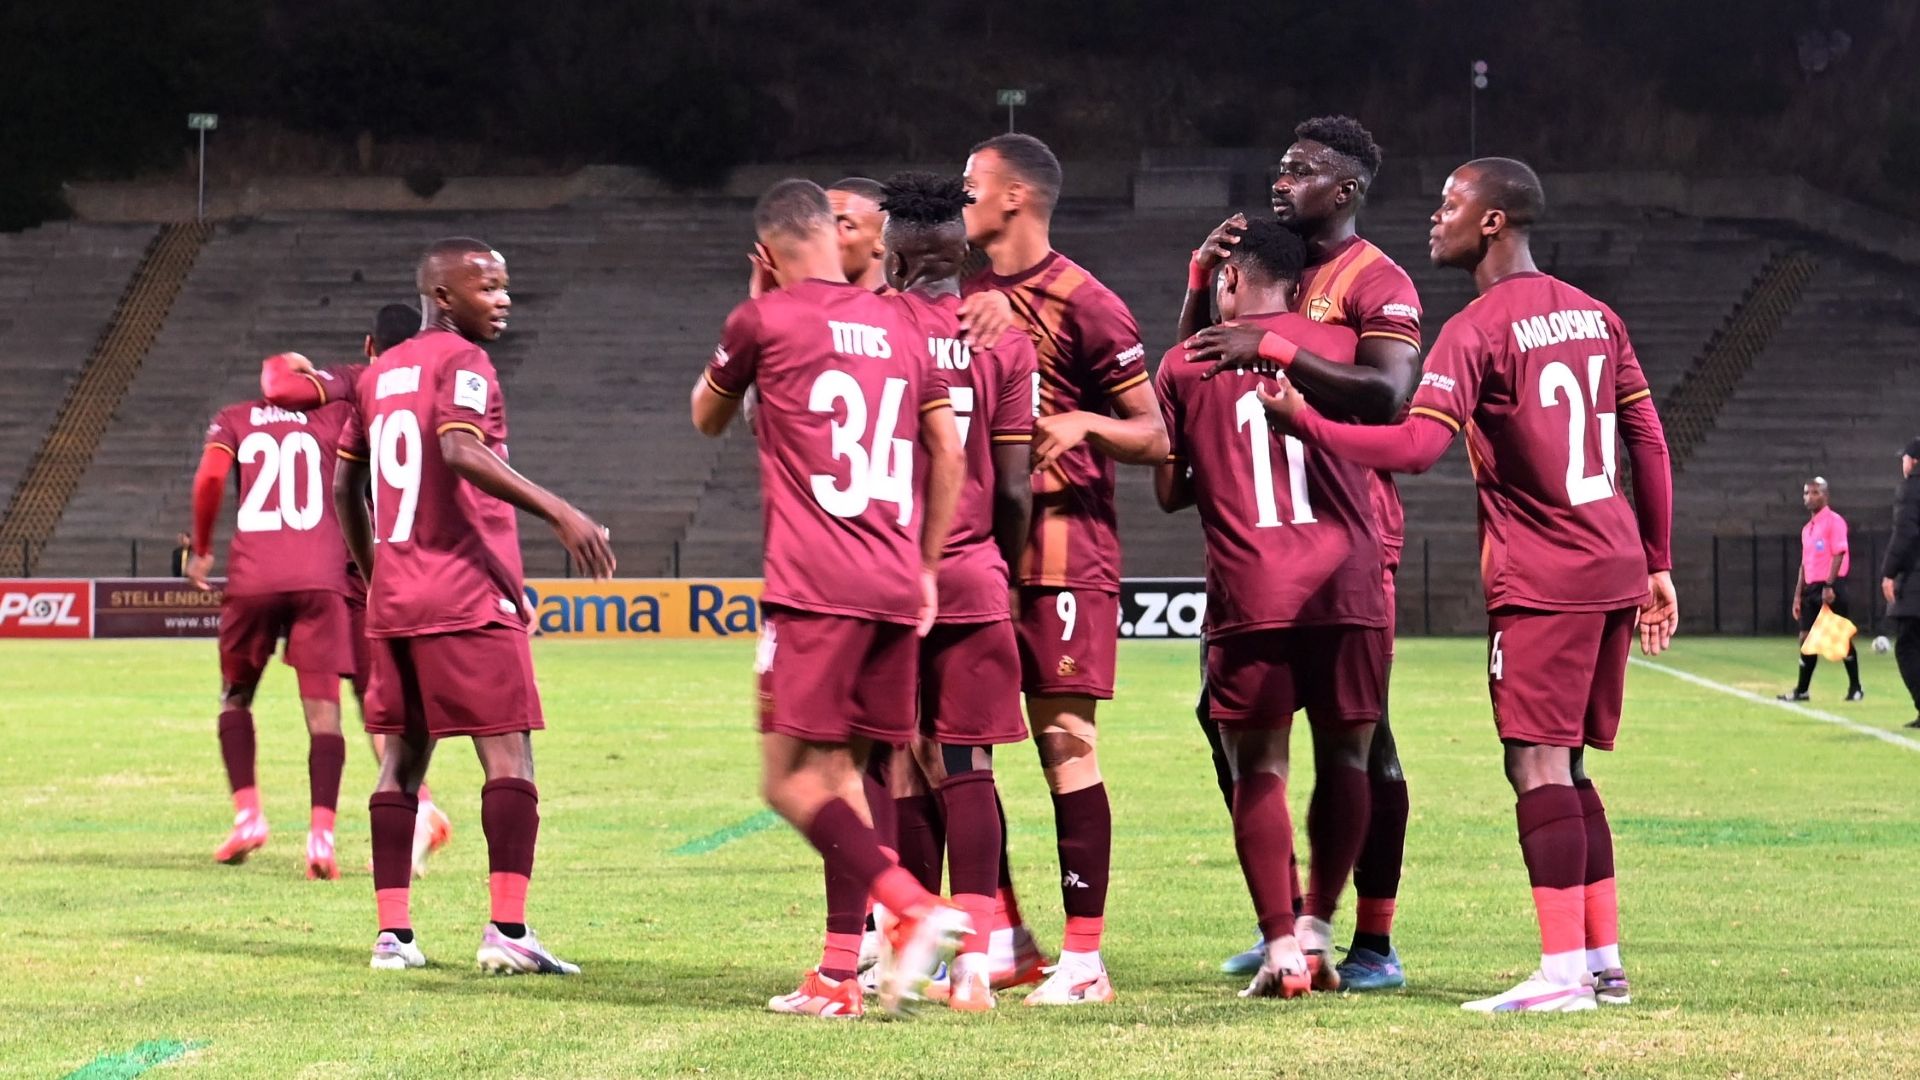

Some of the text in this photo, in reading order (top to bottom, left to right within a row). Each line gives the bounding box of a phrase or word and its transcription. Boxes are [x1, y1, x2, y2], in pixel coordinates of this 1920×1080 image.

[828, 320, 892, 359] TITUS
[808, 369, 914, 528] 34
[1236, 390, 1318, 528] 11
[237, 431, 323, 532] 20
[369, 409, 422, 543] 19
[0, 592, 81, 626] PSL
[689, 584, 757, 636] Ra
[1056, 591, 1077, 641] 9
[1117, 592, 1207, 636] .za
